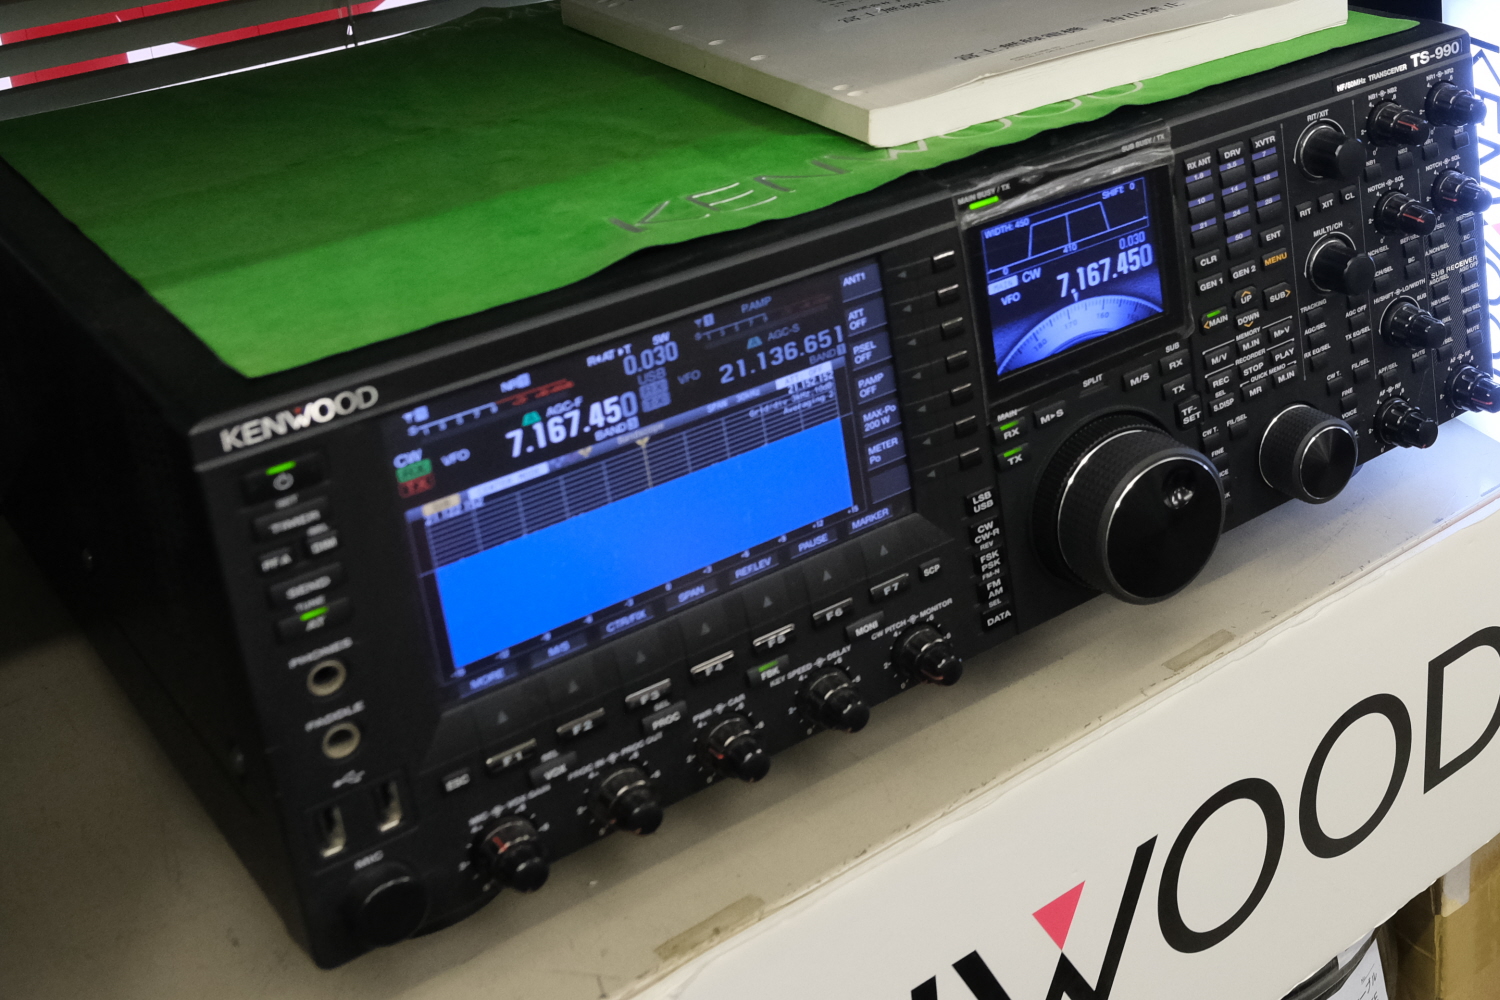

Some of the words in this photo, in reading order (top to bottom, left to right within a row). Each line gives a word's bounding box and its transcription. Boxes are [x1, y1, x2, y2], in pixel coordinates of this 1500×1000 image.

[1368, 63, 1407, 82] TRANSCEIVER
[1410, 41, 1460, 68] TS-990
[1307, 108, 1329, 122] RIT/XIT
[1255, 135, 1276, 149] XVTR
[1224, 147, 1241, 160] DRV
[1322, 197, 1333, 209] XIT
[1014, 217, 1030, 230] 450
[1313, 221, 1343, 238] MULTI/CH
[1119, 230, 1146, 249] 0.030
[1265, 229, 1282, 242] ENT
[1200, 254, 1217, 267] CLR
[1264, 251, 1288, 267] MENU
[1431, 267, 1445, 279] SUB
[1446, 255, 1478, 273] RECEIVER
[842, 271, 866, 287] ANT1
[1022, 267, 1042, 283] CW
[1001, 292, 1021, 306] VFO
[1269, 290, 1286, 303] SUB
[1300, 299, 1327, 313] TRACKING
[1208, 314, 1229, 328] MAIN
[1237, 311, 1260, 326] DOWN
[767, 323, 800, 342] AGC-S
[1235, 326, 1260, 341] MEMORY
[1467, 324, 1480, 334] MUTE
[623, 341, 679, 376] 0.030
[719, 325, 844, 384] 21.136.651
[1235, 348, 1266, 366] RECORDER
[1274, 347, 1294, 362] PLAY
[1243, 362, 1264, 377] STOP
[1083, 374, 1103, 388] SPLIT
[1130, 373, 1150, 387] M/S
[1212, 375, 1230, 388] REC
[219, 384, 379, 453] KENWOOD
[504, 390, 638, 458] 7.167.450
[868, 437, 898, 455] METER
[972, 491, 992, 504] LSB
[973, 499, 994, 513] USB
[851, 507, 889, 530] MARKER
[798, 533, 829, 553] PAUSE
[980, 550, 999, 563] FSK
[922, 563, 941, 577] SCP
[677, 584, 706, 602] SPAN
[918, 598, 953, 619] MONITOR
[987, 609, 1012, 626] DATA
[854, 620, 879, 637] MONI
[652, 711, 681, 731] PROC
